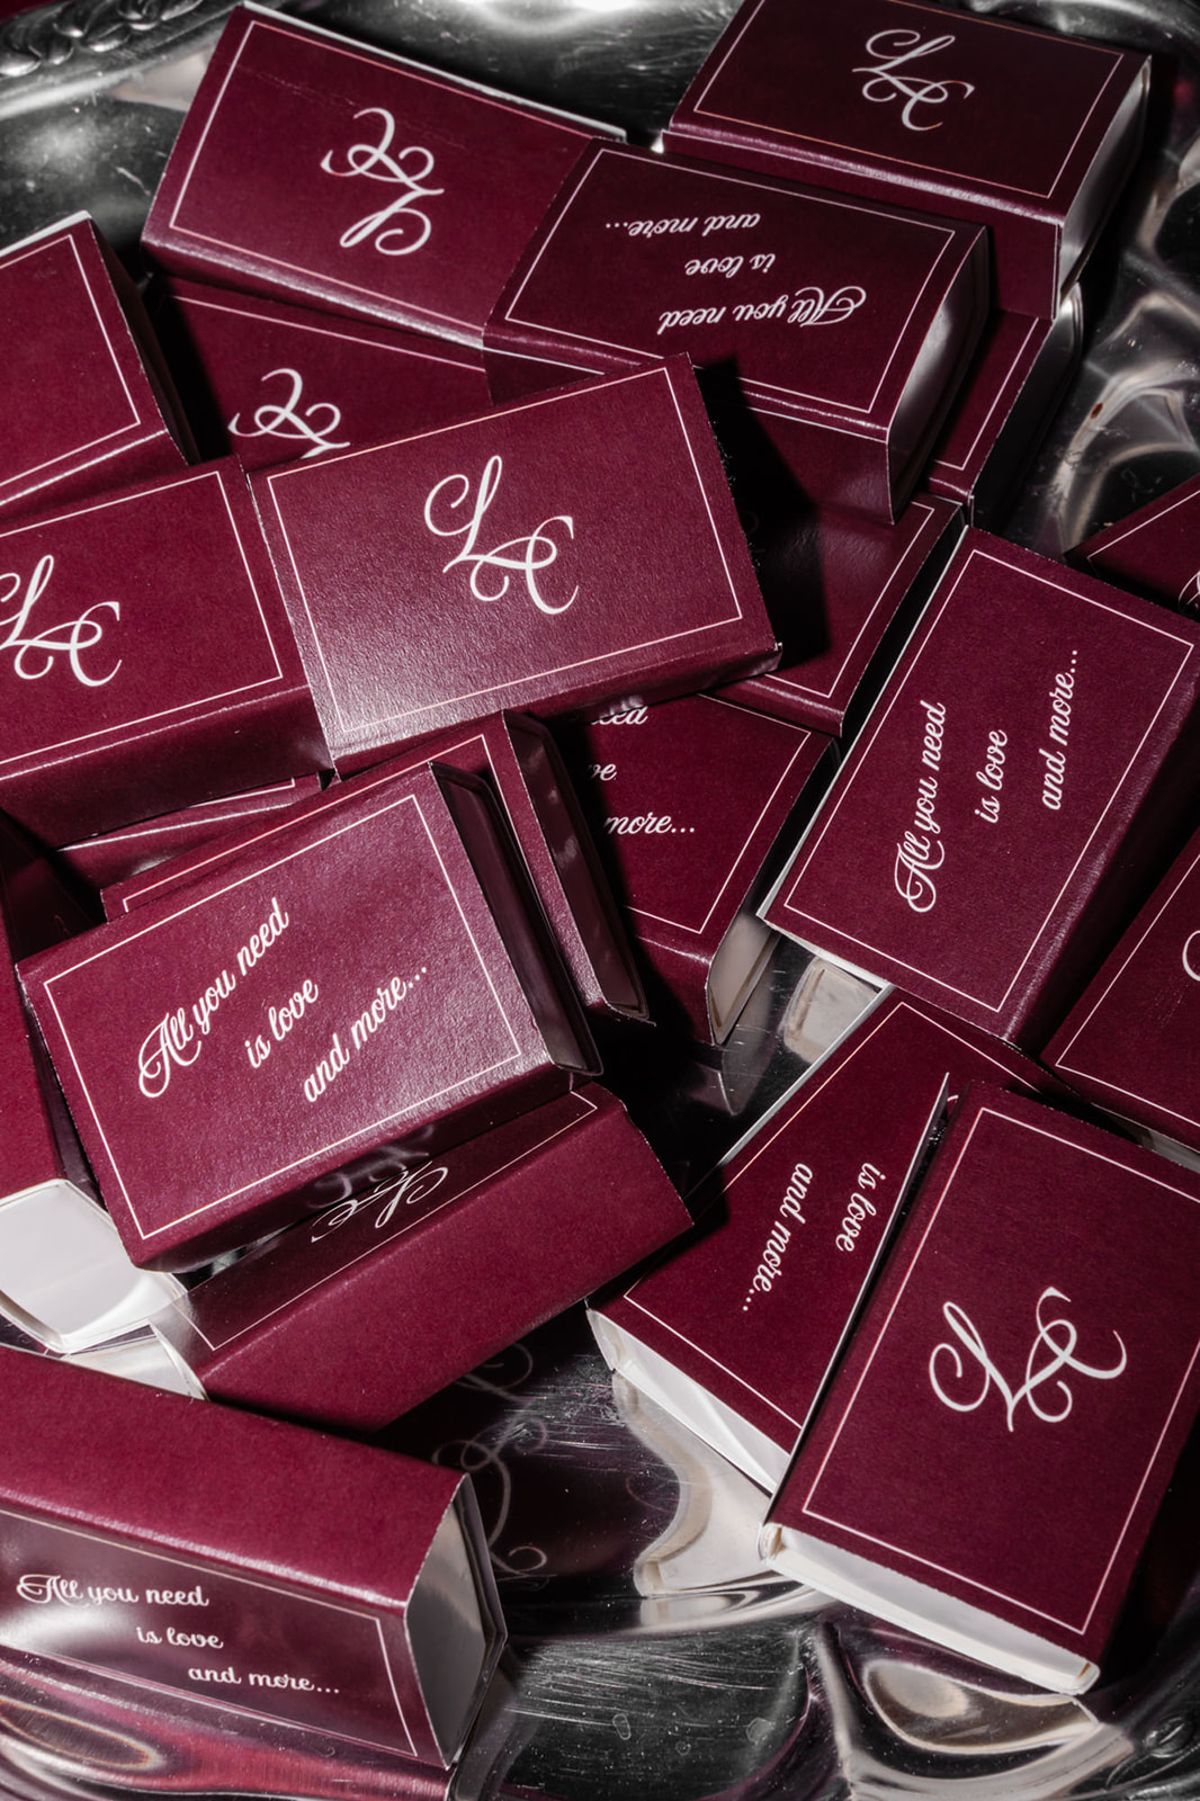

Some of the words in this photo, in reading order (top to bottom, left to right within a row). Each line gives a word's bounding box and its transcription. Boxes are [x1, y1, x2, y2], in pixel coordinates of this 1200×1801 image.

[605, 217, 698, 238] more...
[702, 213, 761, 237] and
[684, 255, 744, 278] love
[749, 253, 776, 273] is
[657, 306, 726, 335] need
[732, 294, 789, 321] you
[787, 285, 866, 327] All
[1049, 650, 1078, 746] more...
[920, 700, 946, 772] need
[976, 729, 1008, 791] love
[1038, 748, 1066, 811] and
[914, 776, 941, 834] you
[974, 795, 1001, 824] is
[894, 831, 945, 913] All
[138, 1012, 202, 1098] All
[192, 969, 236, 1035] you
[237, 897, 289, 976] need
[244, 1035, 271, 1068] is
[268, 979, 319, 1041] love
[303, 1033, 350, 1102] and
[350, 966, 427, 1051] more...
[779, 1163, 813, 1224] and
[857, 1163, 886, 1190] is
[835, 1192, 877, 1252] love
[742, 1221, 791, 1312] more...
[16, 1574, 90, 1607] All
[87, 1584, 139, 1605] you
[145, 1586, 209, 1606] need
[136, 1626, 161, 1644] is
[166, 1627, 224, 1649] love
[188, 1666, 242, 1685] and
[249, 1672, 340, 1694] more...
